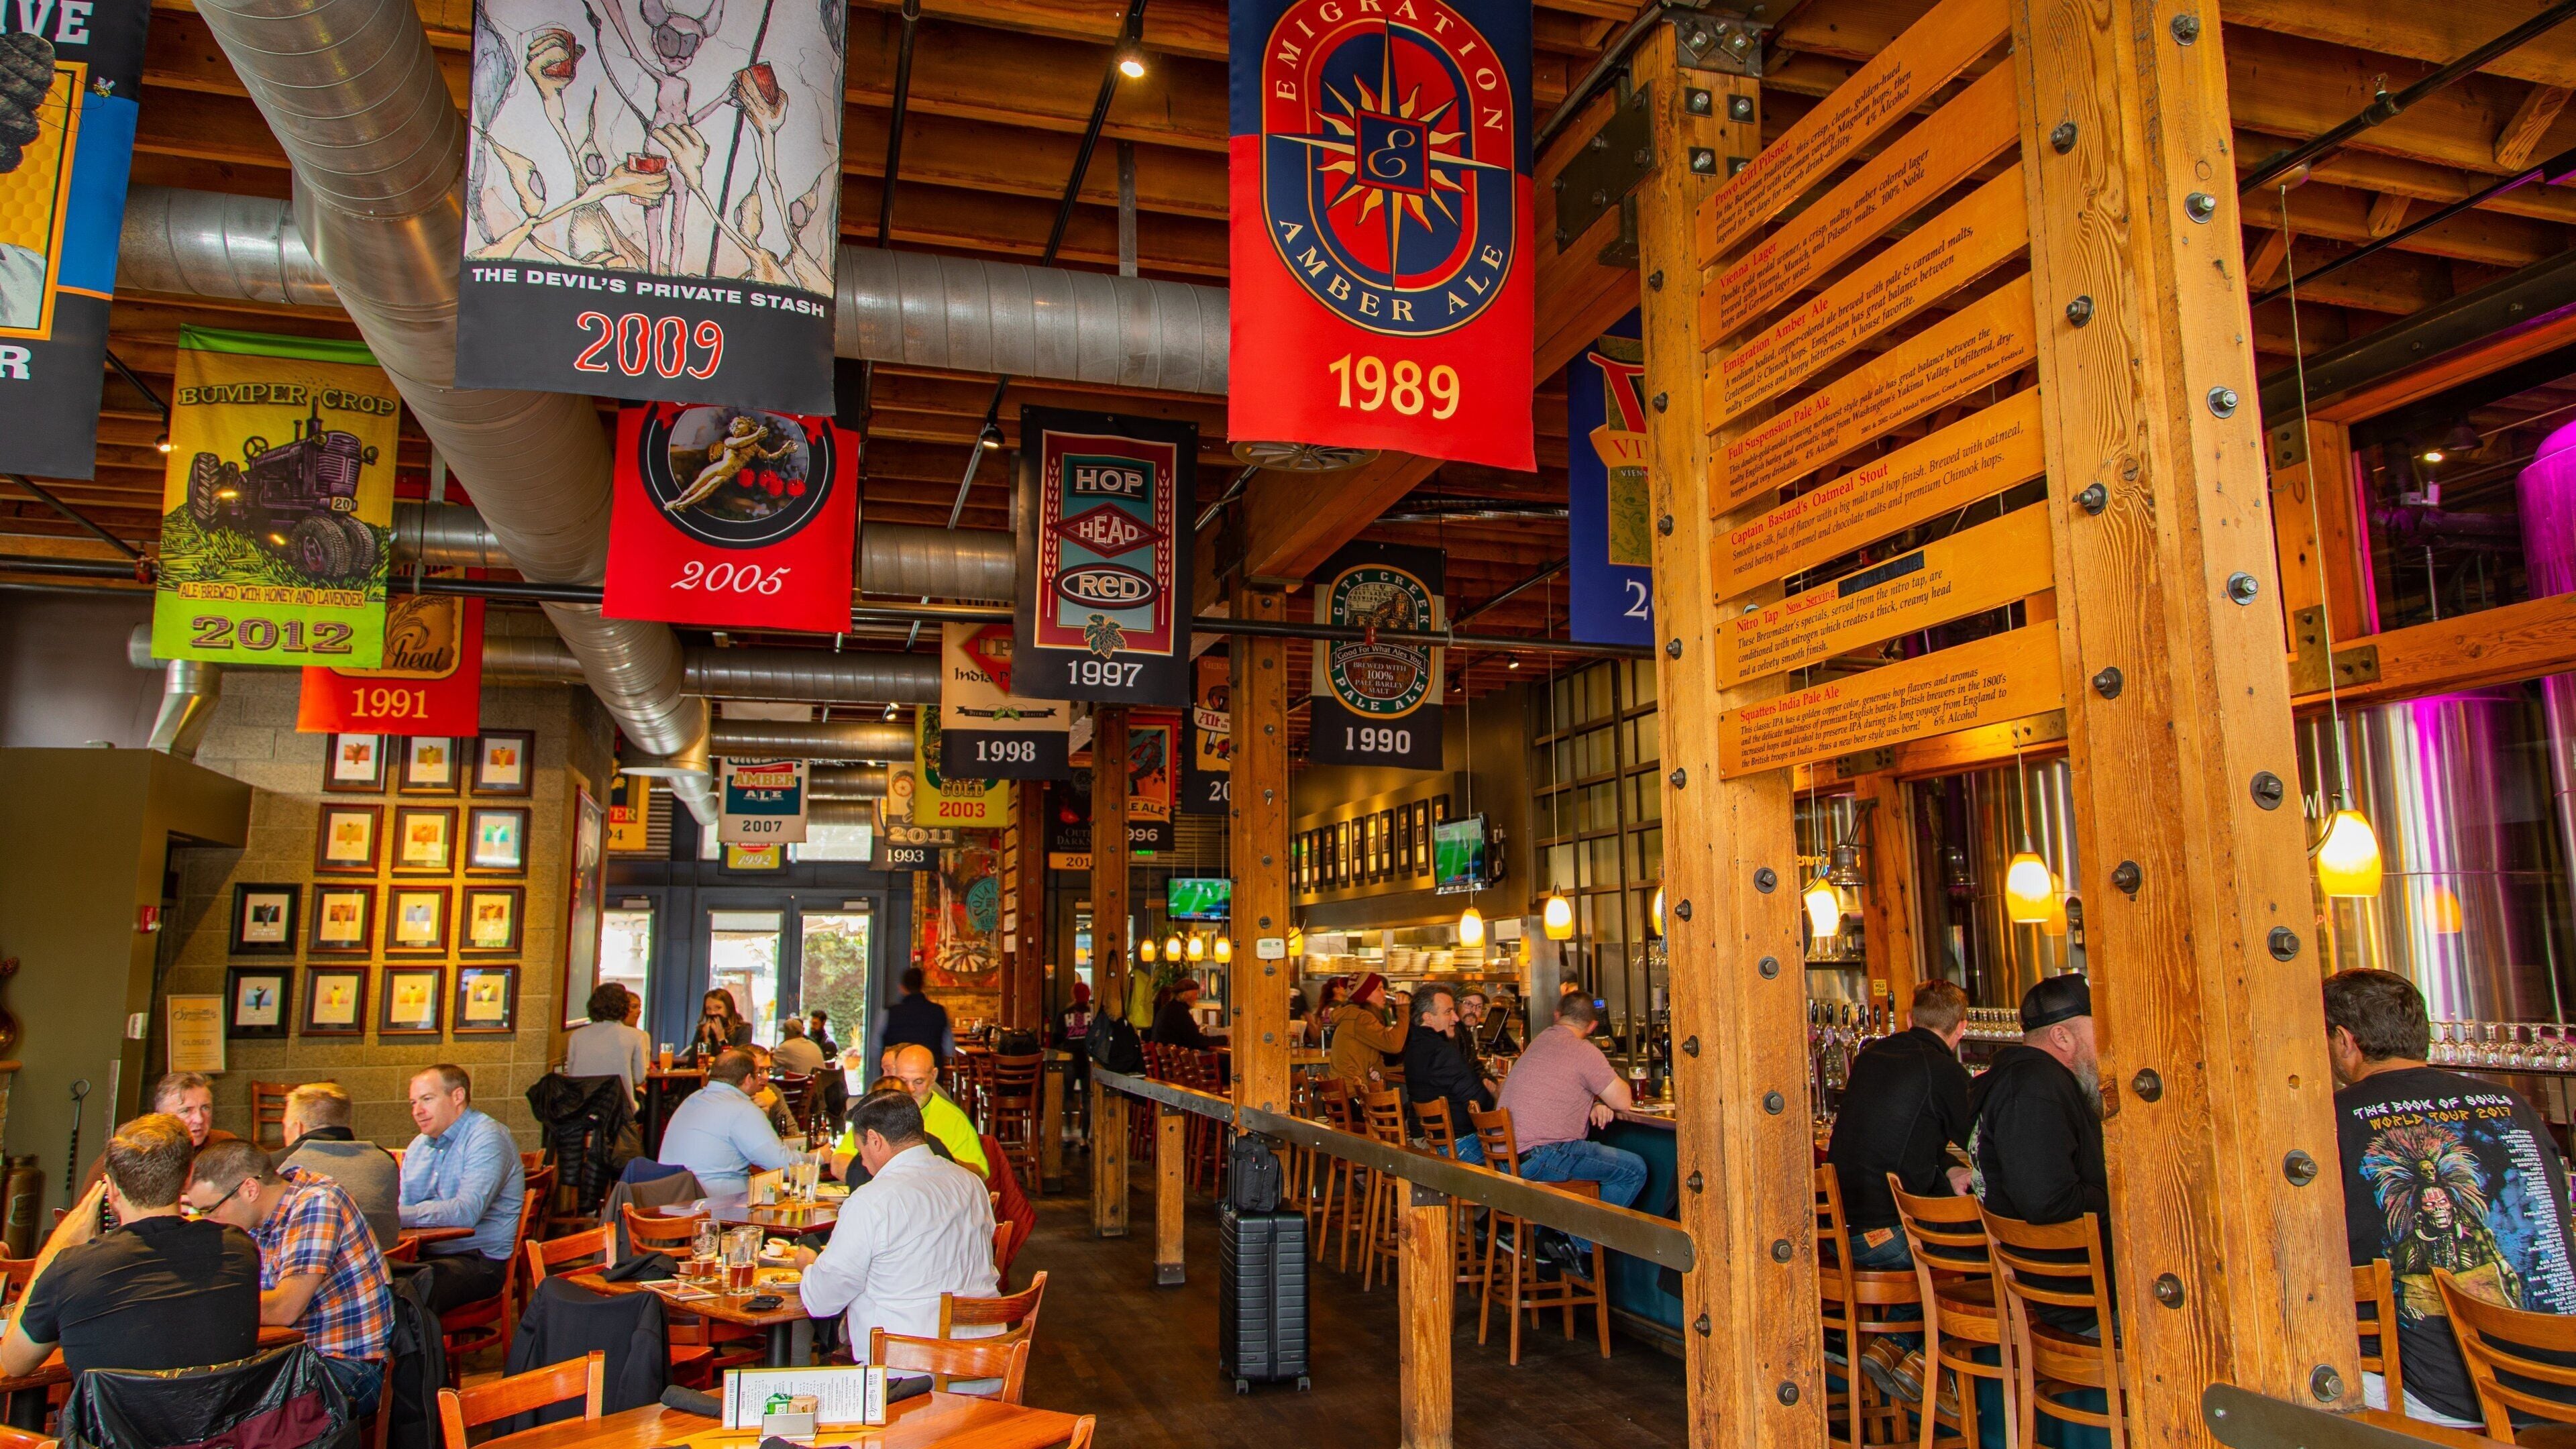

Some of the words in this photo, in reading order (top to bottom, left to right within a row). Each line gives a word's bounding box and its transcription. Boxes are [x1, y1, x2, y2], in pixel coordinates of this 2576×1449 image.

[1276, 0, 1503, 131] EMIGRATION
[1715, 210, 1723, 221] In
[1723, 201, 1733, 213] the
[1734, 177, 1762, 205] Bavarian
[1763, 152, 1794, 182] tradition,
[1795, 138, 1809, 156] this
[1810, 123, 1831, 144] crisp,
[1831, 105, 1853, 127] clean,
[1853, 60, 1900, 111] golden-hued
[1715, 182, 1738, 207] Provo
[1739, 163, 1757, 185] Girl
[1758, 138, 1789, 171] Pilsner
[1279, 219, 1415, 321] AMBER
[1448, 245, 1503, 315] ALE
[1719, 263, 1749, 288] Vienna
[1752, 241, 1777, 266] Lager
[472, 268, 517, 282] THE
[527, 271, 626, 292] DEVIL'S
[637, 282, 741, 304] PRIVATE
[751, 292, 824, 317] STASH
[1721, 315, 1735, 329] hops
[1735, 303, 1748, 320] and
[1748, 288, 1773, 311] German
[1774, 276, 1791, 293] lager
[1792, 261, 1812, 284] yeast.
[574, 311, 724, 379] 2009
[1723, 337, 1770, 374] Emigration
[1774, 313, 1806, 341] Amber
[1811, 299, 1828, 318] Ale
[1725, 399, 1742, 415] malty
[1743, 380, 1774, 405] sweetness
[1774, 369, 1787, 386] and
[1788, 358, 1809, 378] hoppy
[1810, 337, 1847, 364] bitterness.
[1850, 327, 1857, 340] A
[1858, 315, 1880, 335] house
[1882, 295, 1915, 322] favorite.
[1328, 353, 1460, 419] 1989
[1888, 407, 1902, 420] Gold
[1902, 398, 1919, 413] Medal
[1941, 380, 1957, 393] Great
[1958, 367, 1986, 384] American
[1986, 360, 2000, 371] Beer
[2000, 345, 2024, 364] Festival
[179, 383, 307, 405] BUMPER
[321, 389, 394, 415] CROP
[1727, 441, 1743, 461] Full
[1744, 418, 1792, 451] Suspension
[1792, 405, 1812, 425] Pale
[1814, 395, 1831, 413] Ale
[1077, 470, 1143, 494] HOP
[334, 498, 350, 510] 20
[1730, 521, 1764, 545] Captain
[1767, 500, 1808, 529] Bastard's
[1812, 476, 1854, 507] Oatmeal
[1858, 462, 1888, 486] Stout
[1733, 557, 1754, 576] roasted
[1754, 551, 1775, 567] barley,
[1790, 529, 1817, 551] caramel
[1817, 523, 1831, 539] and
[1832, 511, 1864, 533] chocolate
[1865, 501, 1886, 519] malts
[1887, 491, 1902, 509] and
[1904, 478, 1941, 506] premium
[1942, 459, 1979, 485] Chinook
[1980, 452, 2004, 470] hops.
[1079, 516, 1138, 545] HEAD
[671, 561, 790, 594] 2005
[180, 584, 198, 598] ALE
[201, 585, 237, 600] BREWED
[240, 586, 261, 600] WITH
[266, 588, 294, 602] HONEY
[296, 590, 315, 603] AND
[317, 590, 364, 606] LAVENDER
[1334, 573, 1363, 615] CITY
[1380, 572, 1430, 623] CREEK
[1735, 617, 1759, 634] Nitro
[1762, 610, 1779, 625] Tap
[1785, 601, 1802, 614] Now
[1804, 589, 1835, 609] Serving
[190, 615, 353, 653] 2012
[978, 638, 1012, 656] IP
[392, 639, 443, 669] heat
[1337, 648, 1357, 659] Good
[1372, 645, 1391, 653] What
[1392, 648, 1407, 658] Ales
[1738, 663, 1750, 678] and
[1751, 665, 1756, 674] a
[1756, 657, 1780, 672] velvety
[1780, 646, 1805, 665] smooth
[1805, 639, 1828, 660] finish.
[955, 667, 994, 683] India
[1068, 660, 1143, 686] 1997
[1367, 670, 1393, 681] 100%
[1386, 663, 1407, 672] WITH
[350, 688, 429, 718] 1991
[1336, 676, 1380, 710] PALE
[1395, 682, 1425, 710] ALE
[1739, 704, 1776, 724] Squatters
[1778, 696, 1801, 712] India
[1802, 690, 1821, 706] Pale
[1823, 685, 1839, 700] Ale
[1933, 713, 1945, 727] 6%
[1947, 706, 1978, 724] Alcohol
[977, 741, 1035, 762] 1998
[1346, 727, 1411, 753] 1990
[731, 771, 797, 788] AMBER
[941, 782, 985, 797] GOLD
[745, 790, 782, 800] ALE
[939, 802, 985, 817] 2003
[1141, 803, 1166, 815] ALE
[743, 820, 782, 832] 2007
[890, 826, 955, 844] 2011
[1128, 828, 1158, 841] 996
[738, 855, 771, 865] 1992
[887, 849, 924, 862] 1993
[1066, 857, 1089, 867] 201
[2353, 1103, 2389, 1120] THE
[2391, 1099, 2435, 1113] BOOK
[2438, 1097, 2459, 1109] OF
[2464, 1094, 2513, 1106] SOULS
[2369, 1114, 2424, 1130] WORLD
[2428, 1110, 2469, 1122] TOUR
[2476, 1107, 2511, 1118] 2017
